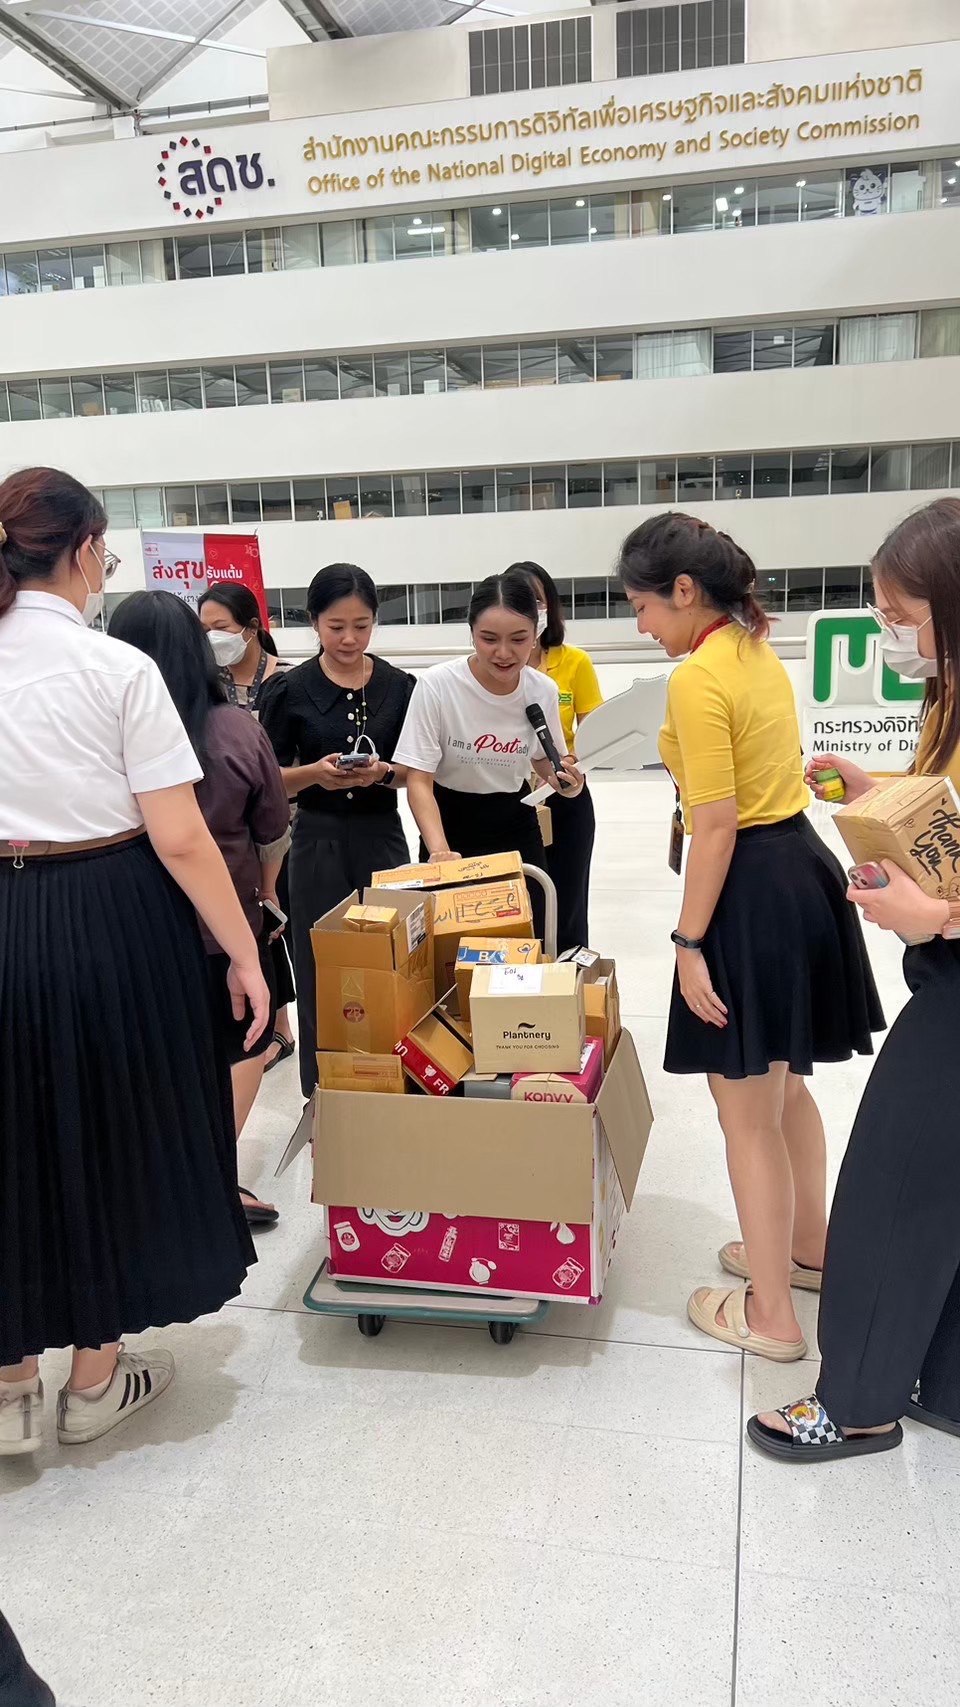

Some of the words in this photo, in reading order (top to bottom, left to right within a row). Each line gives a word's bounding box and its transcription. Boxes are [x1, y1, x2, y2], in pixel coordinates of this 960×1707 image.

[303, 68, 924, 161] สำนักงานคณะกรรมการดิจิทัลเพื่อเศรษฐกิจและสังคมแห่งชาติ
[308, 166, 361, 195] Office
[366, 165, 385, 187] of
[391, 166, 421, 186] the
[427, 152, 505, 182] National
[512, 146, 572, 178] Digital
[580, 141, 667, 168] Economy
[675, 132, 711, 155] and
[719, 124, 790, 150] Society
[797, 111, 921, 141] Commission
[178, 151, 276, 196] สดช.
[207, 564, 243, 579] รับแต้ม
[813, 716, 920, 734] กระทรวงดิจิทั
[448, 736, 451, 745] I
[452, 739, 465, 749] am
[466, 742, 472, 750] a
[473, 734, 521, 754] Post
[812, 740, 872, 754] Ministry
[878, 740, 892, 752] of
[503, 1031, 551, 1041] Plantnery
[433, 1078, 450, 1095] FR
